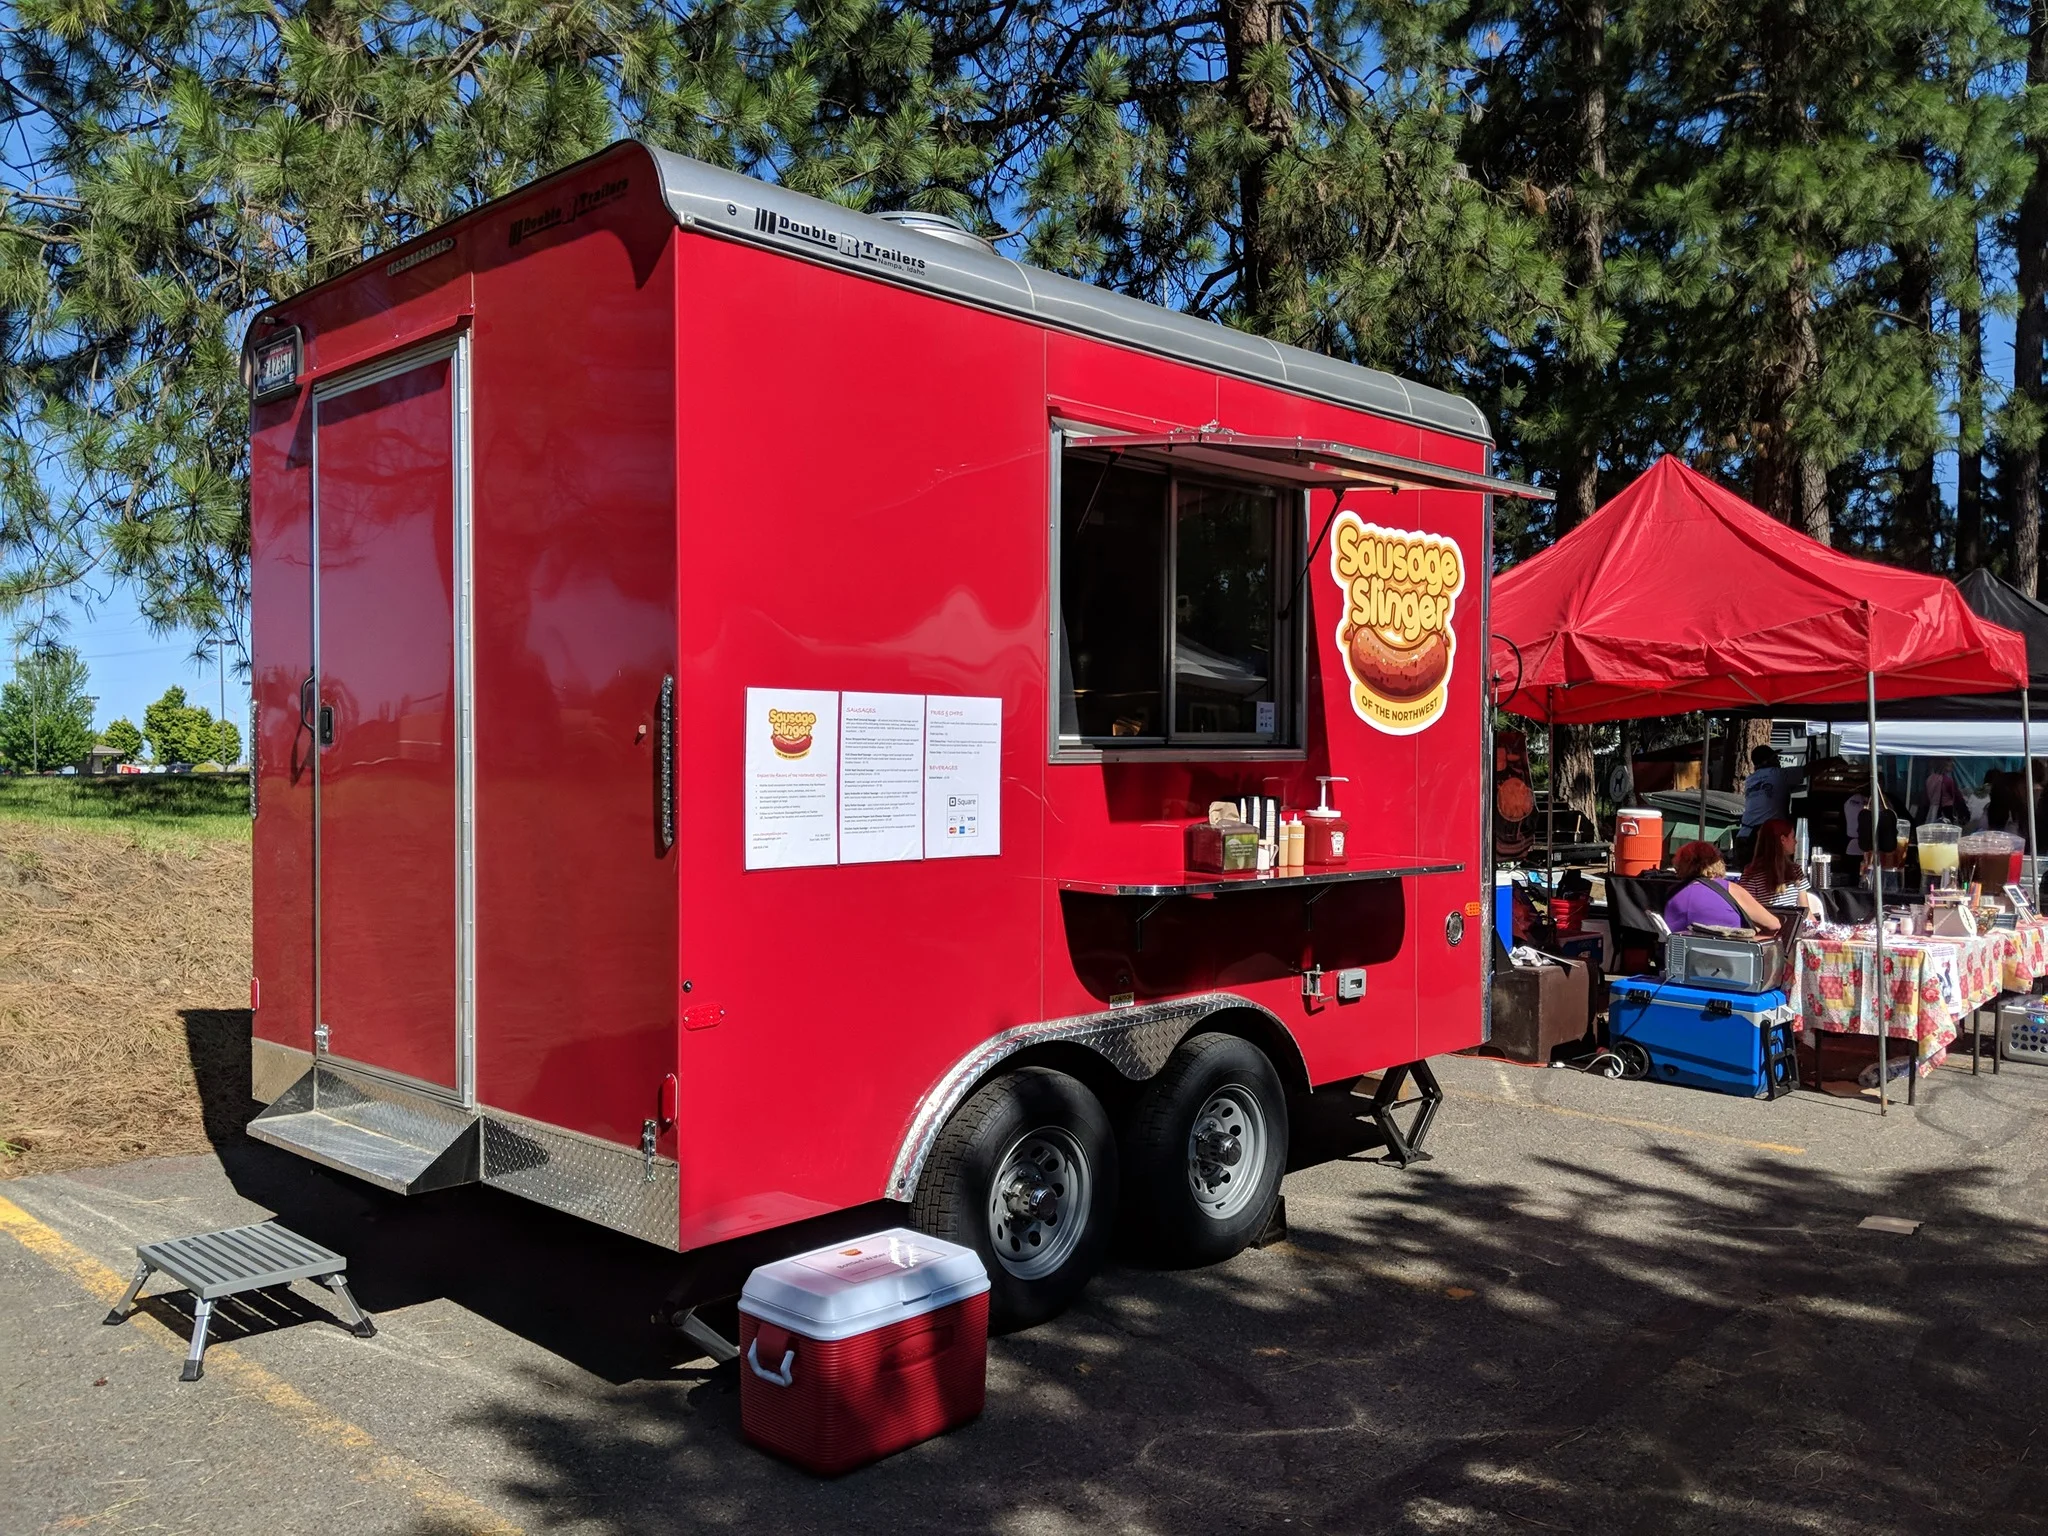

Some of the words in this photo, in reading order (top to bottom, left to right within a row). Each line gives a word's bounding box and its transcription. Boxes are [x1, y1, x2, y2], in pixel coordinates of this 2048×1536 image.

[779, 215, 836, 243] Double
[840, 232, 859, 259] R
[863, 241, 926, 269] Trailers
[878, 258, 905, 271] Nampa,
[906, 265, 926, 276] Idaho
[1339, 524, 1459, 596] Sausage
[1351, 577, 1449, 641] Slinger
[769, 709, 816, 726] Sausage
[1361, 695, 1373, 709] OF
[1374, 703, 1390, 719] THE
[1392, 697, 1438, 721] NORTHWEST
[773, 722, 812, 739] Slinger
[957, 798, 976, 806] Square
